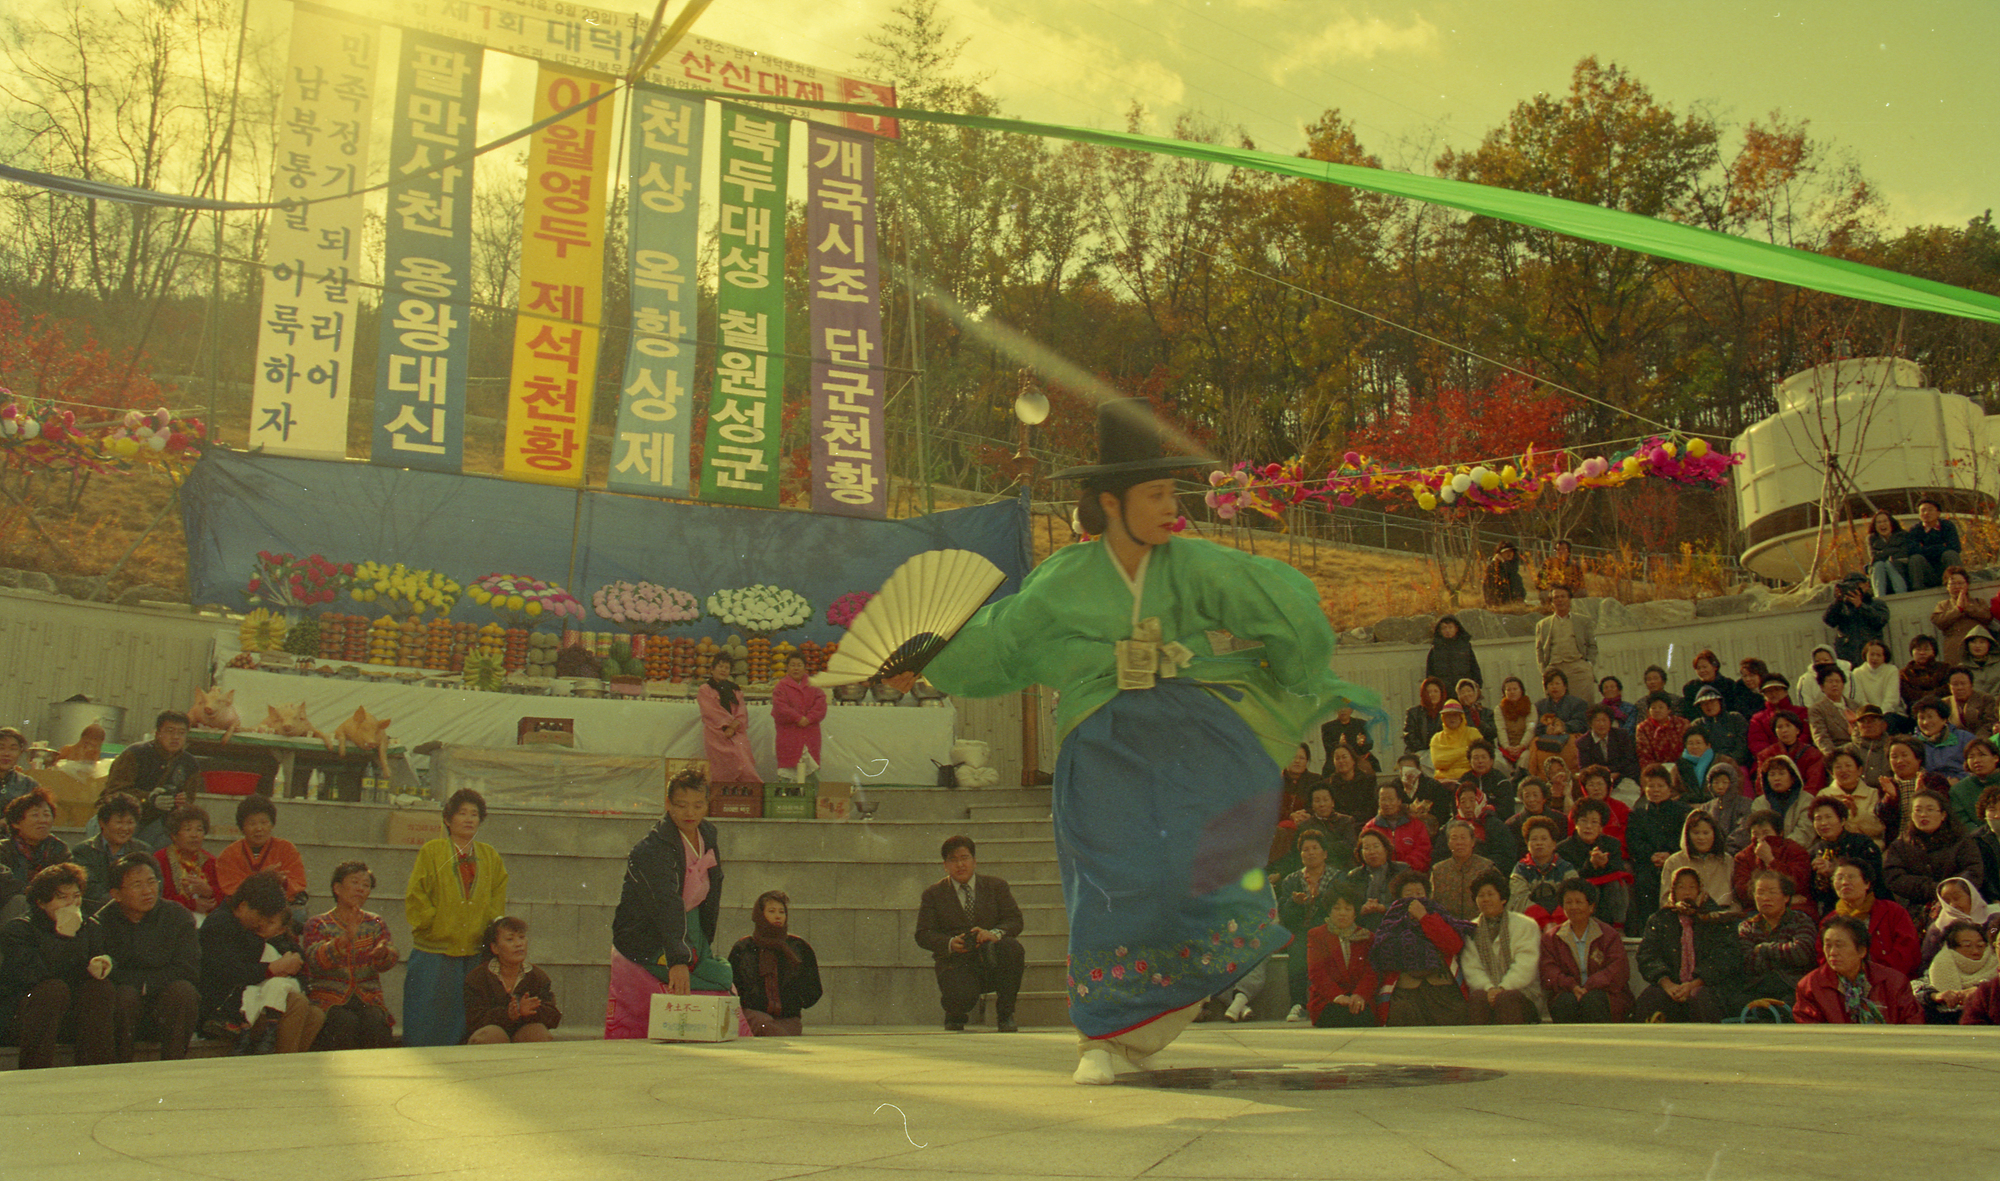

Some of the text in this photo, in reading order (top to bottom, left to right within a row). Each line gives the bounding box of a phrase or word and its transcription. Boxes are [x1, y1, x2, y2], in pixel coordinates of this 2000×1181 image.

[395, 44, 471, 238] 팔만사천
[680, 50, 824, 111] 산신대제
[257, 66, 328, 442] 남북통일 이룩하자
[520, 78, 601, 472] 이월영두 제석천황
[615, 99, 692, 486] 천상 옥황상제
[721, 114, 780, 289] 북두대성
[307, 226, 354, 399] 되살리어
[383, 257, 458, 455] 용왕대신
[711, 309, 769, 491] 칠원성군
[814, 137, 878, 505] 개국시조 단군천황
[664, 1002, 702, 1012] 身土不二
